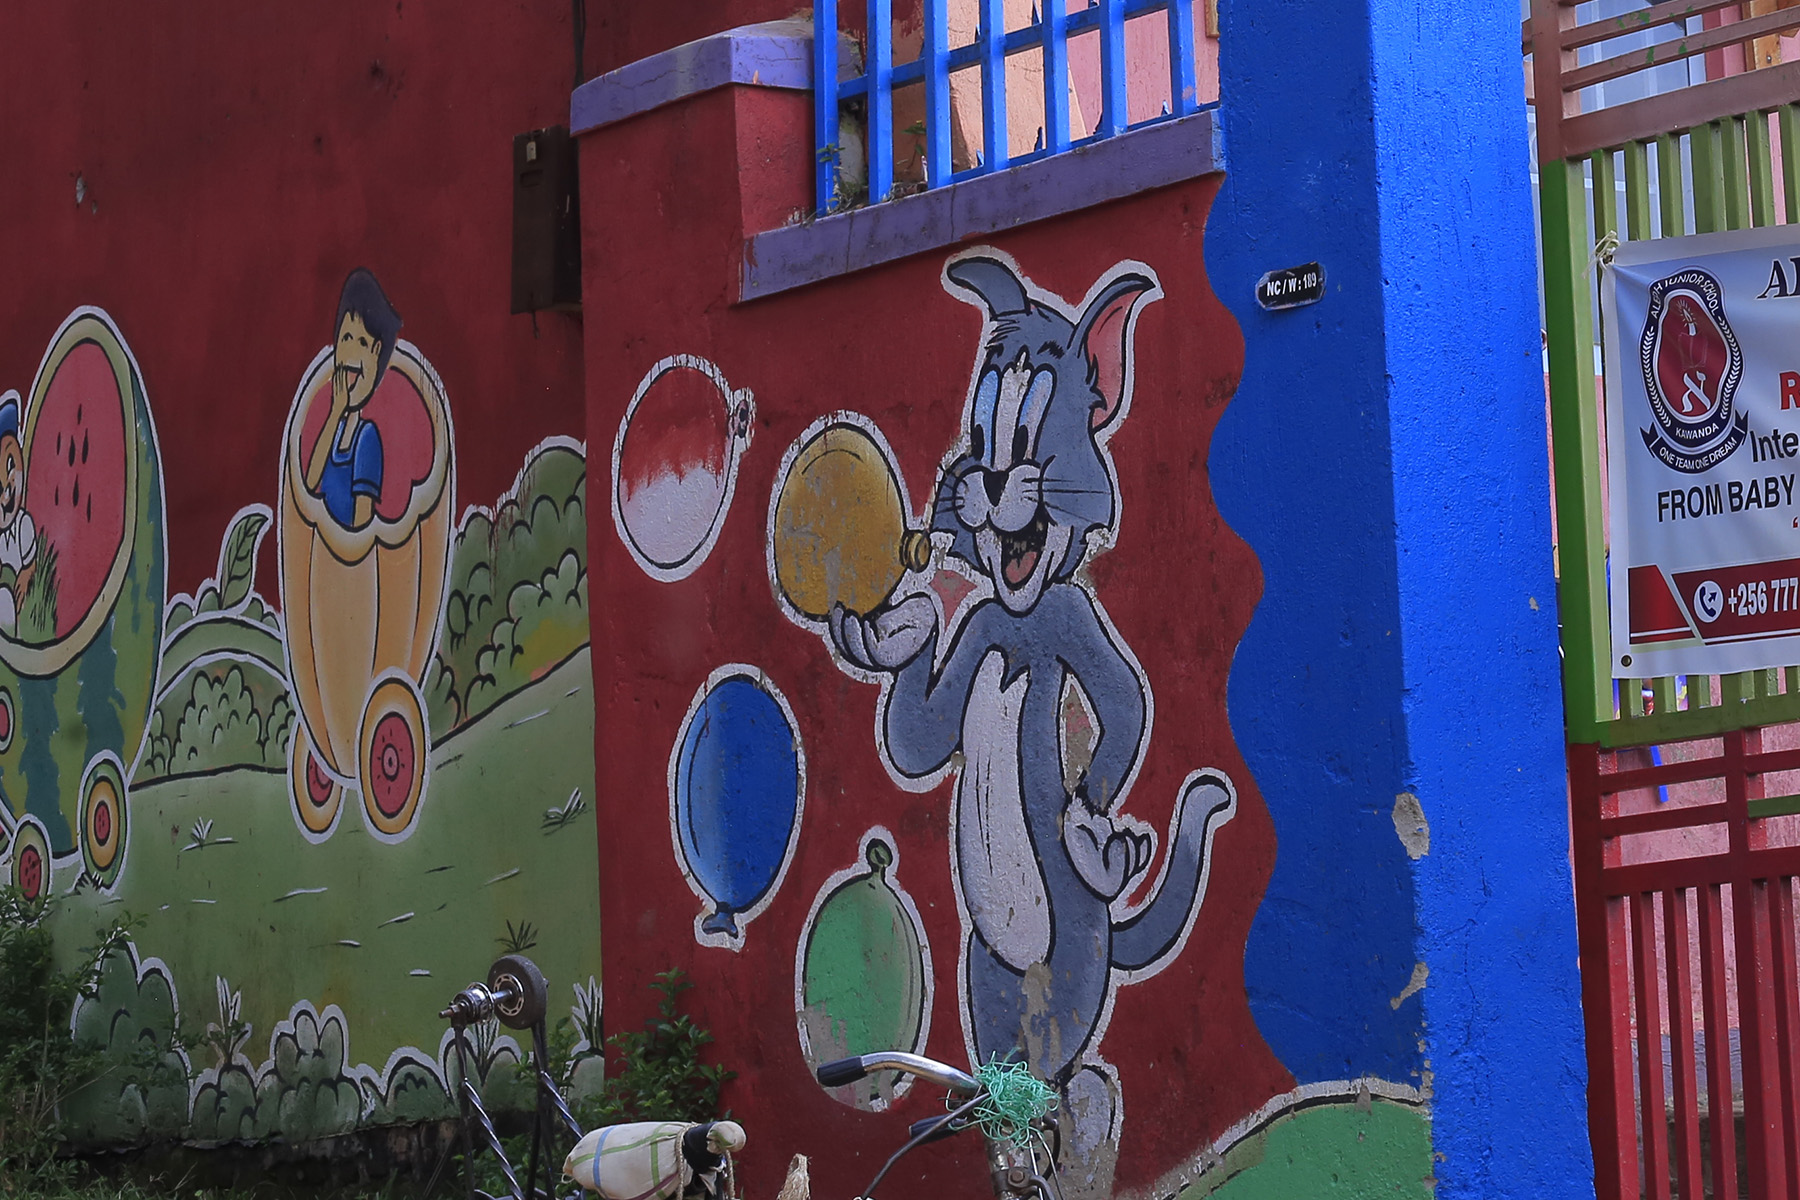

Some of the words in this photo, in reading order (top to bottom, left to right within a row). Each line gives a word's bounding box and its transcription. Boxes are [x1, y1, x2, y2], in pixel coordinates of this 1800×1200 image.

[1664, 273, 1704, 288] JUNIOR
[1701, 279, 1720, 316] SCHOOL
[1675, 422, 1720, 440] KAWANDA
[1659, 446, 1674, 464] ONE
[1674, 456, 1694, 469] TEAM
[1694, 456, 1709, 469] ONE
[1709, 437, 1738, 462] DREAM
[1657, 485, 1724, 523] FROM
[1727, 473, 1796, 513] BABY
[1728, 580, 1768, 617] +256
[1771, 576, 1800, 613] 777
